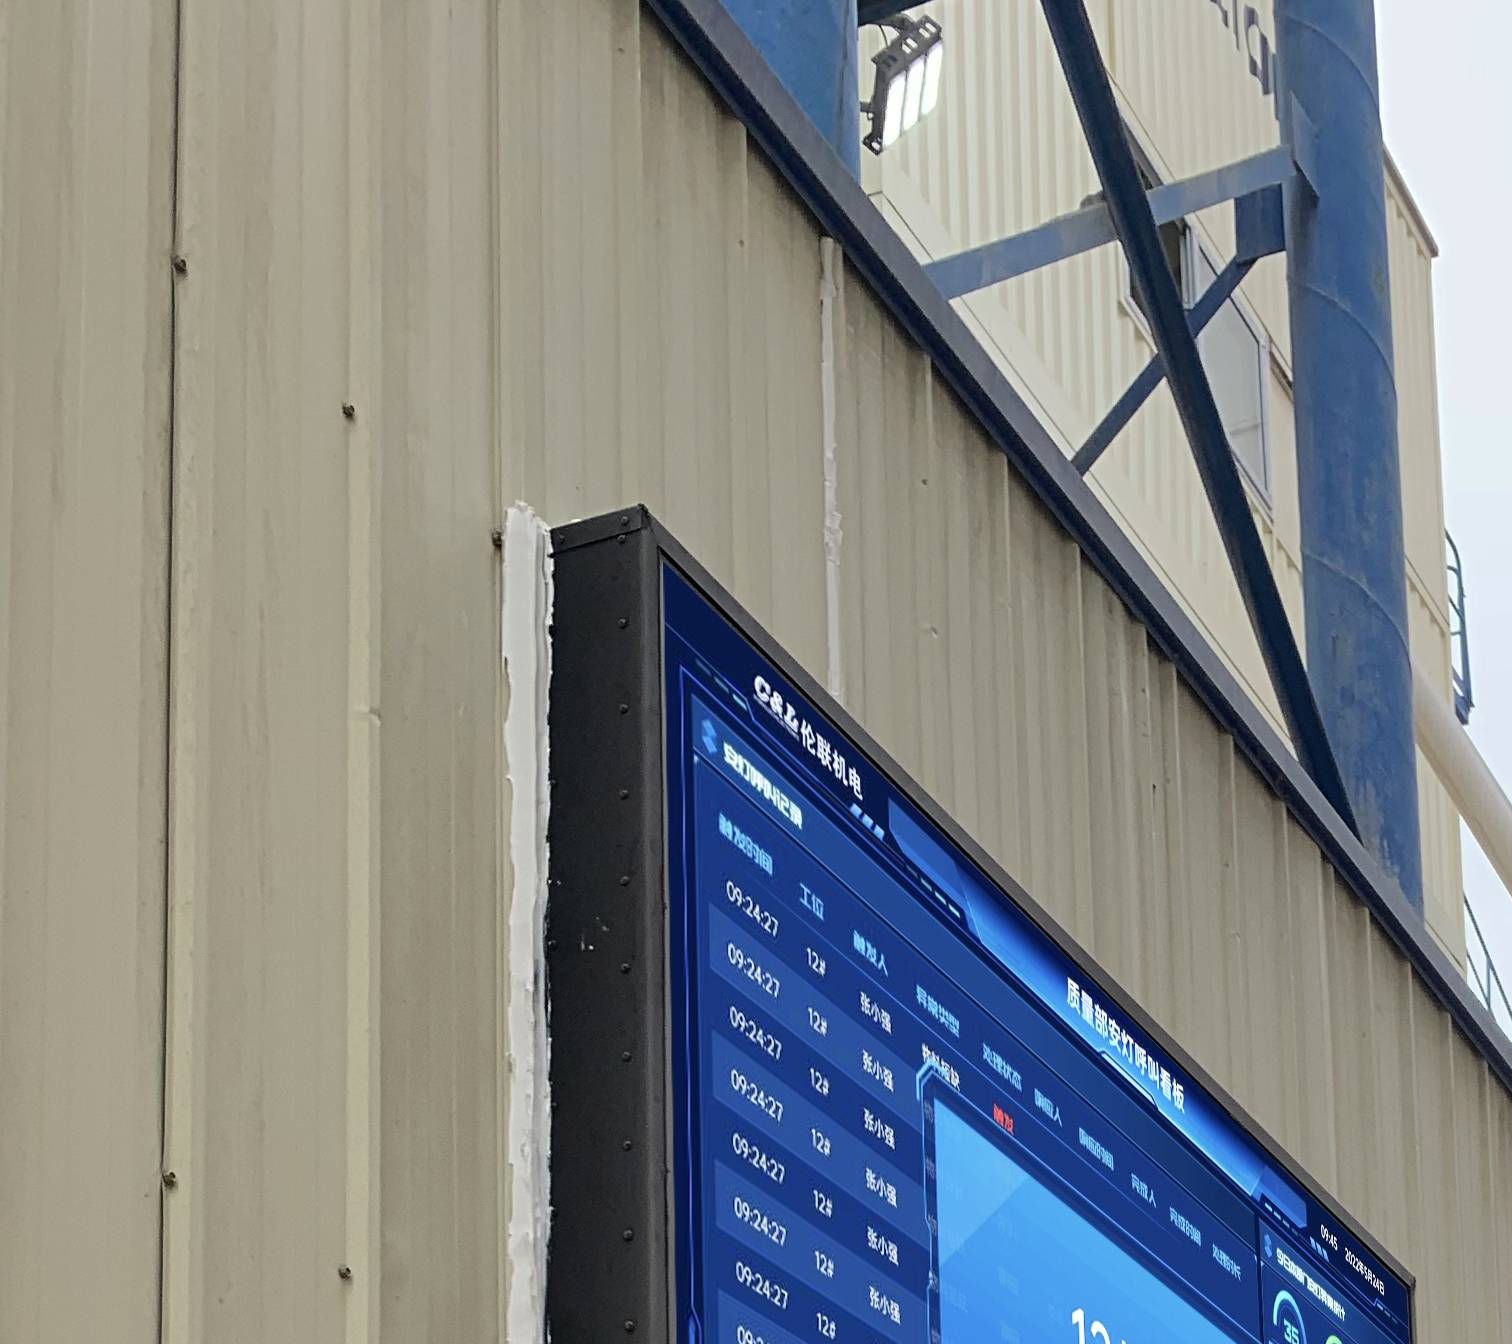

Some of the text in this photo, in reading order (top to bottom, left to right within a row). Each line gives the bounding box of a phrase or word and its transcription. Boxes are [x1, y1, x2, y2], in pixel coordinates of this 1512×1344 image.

[800, 717, 862, 802] 伦联机电
[726, 877, 779, 943] 09:24:27
[806, 945, 826, 981] 12#
[859, 989, 892, 1037] 张小强
[799, 881, 824, 922] 工位
[727, 939, 894, 1094] 09:24:27 12# 张小强
[729, 1003, 895, 1152] 09:24:27 12# 张小强
[1066, 974, 1184, 1115] 质量部安灯呼叫看板
[731, 1066, 897, 1210] 09:24:27 12# 张小强
[732, 1130, 899, 1268] 09:24:27 12# 张小强
[734, 1193, 901, 1326] 09:24:27 12# 张小强
[735, 1257, 788, 1312] 09:24:27
[816, 1309, 836, 1341] 12#
[1320, 1222, 1337, 1252] 09:45
